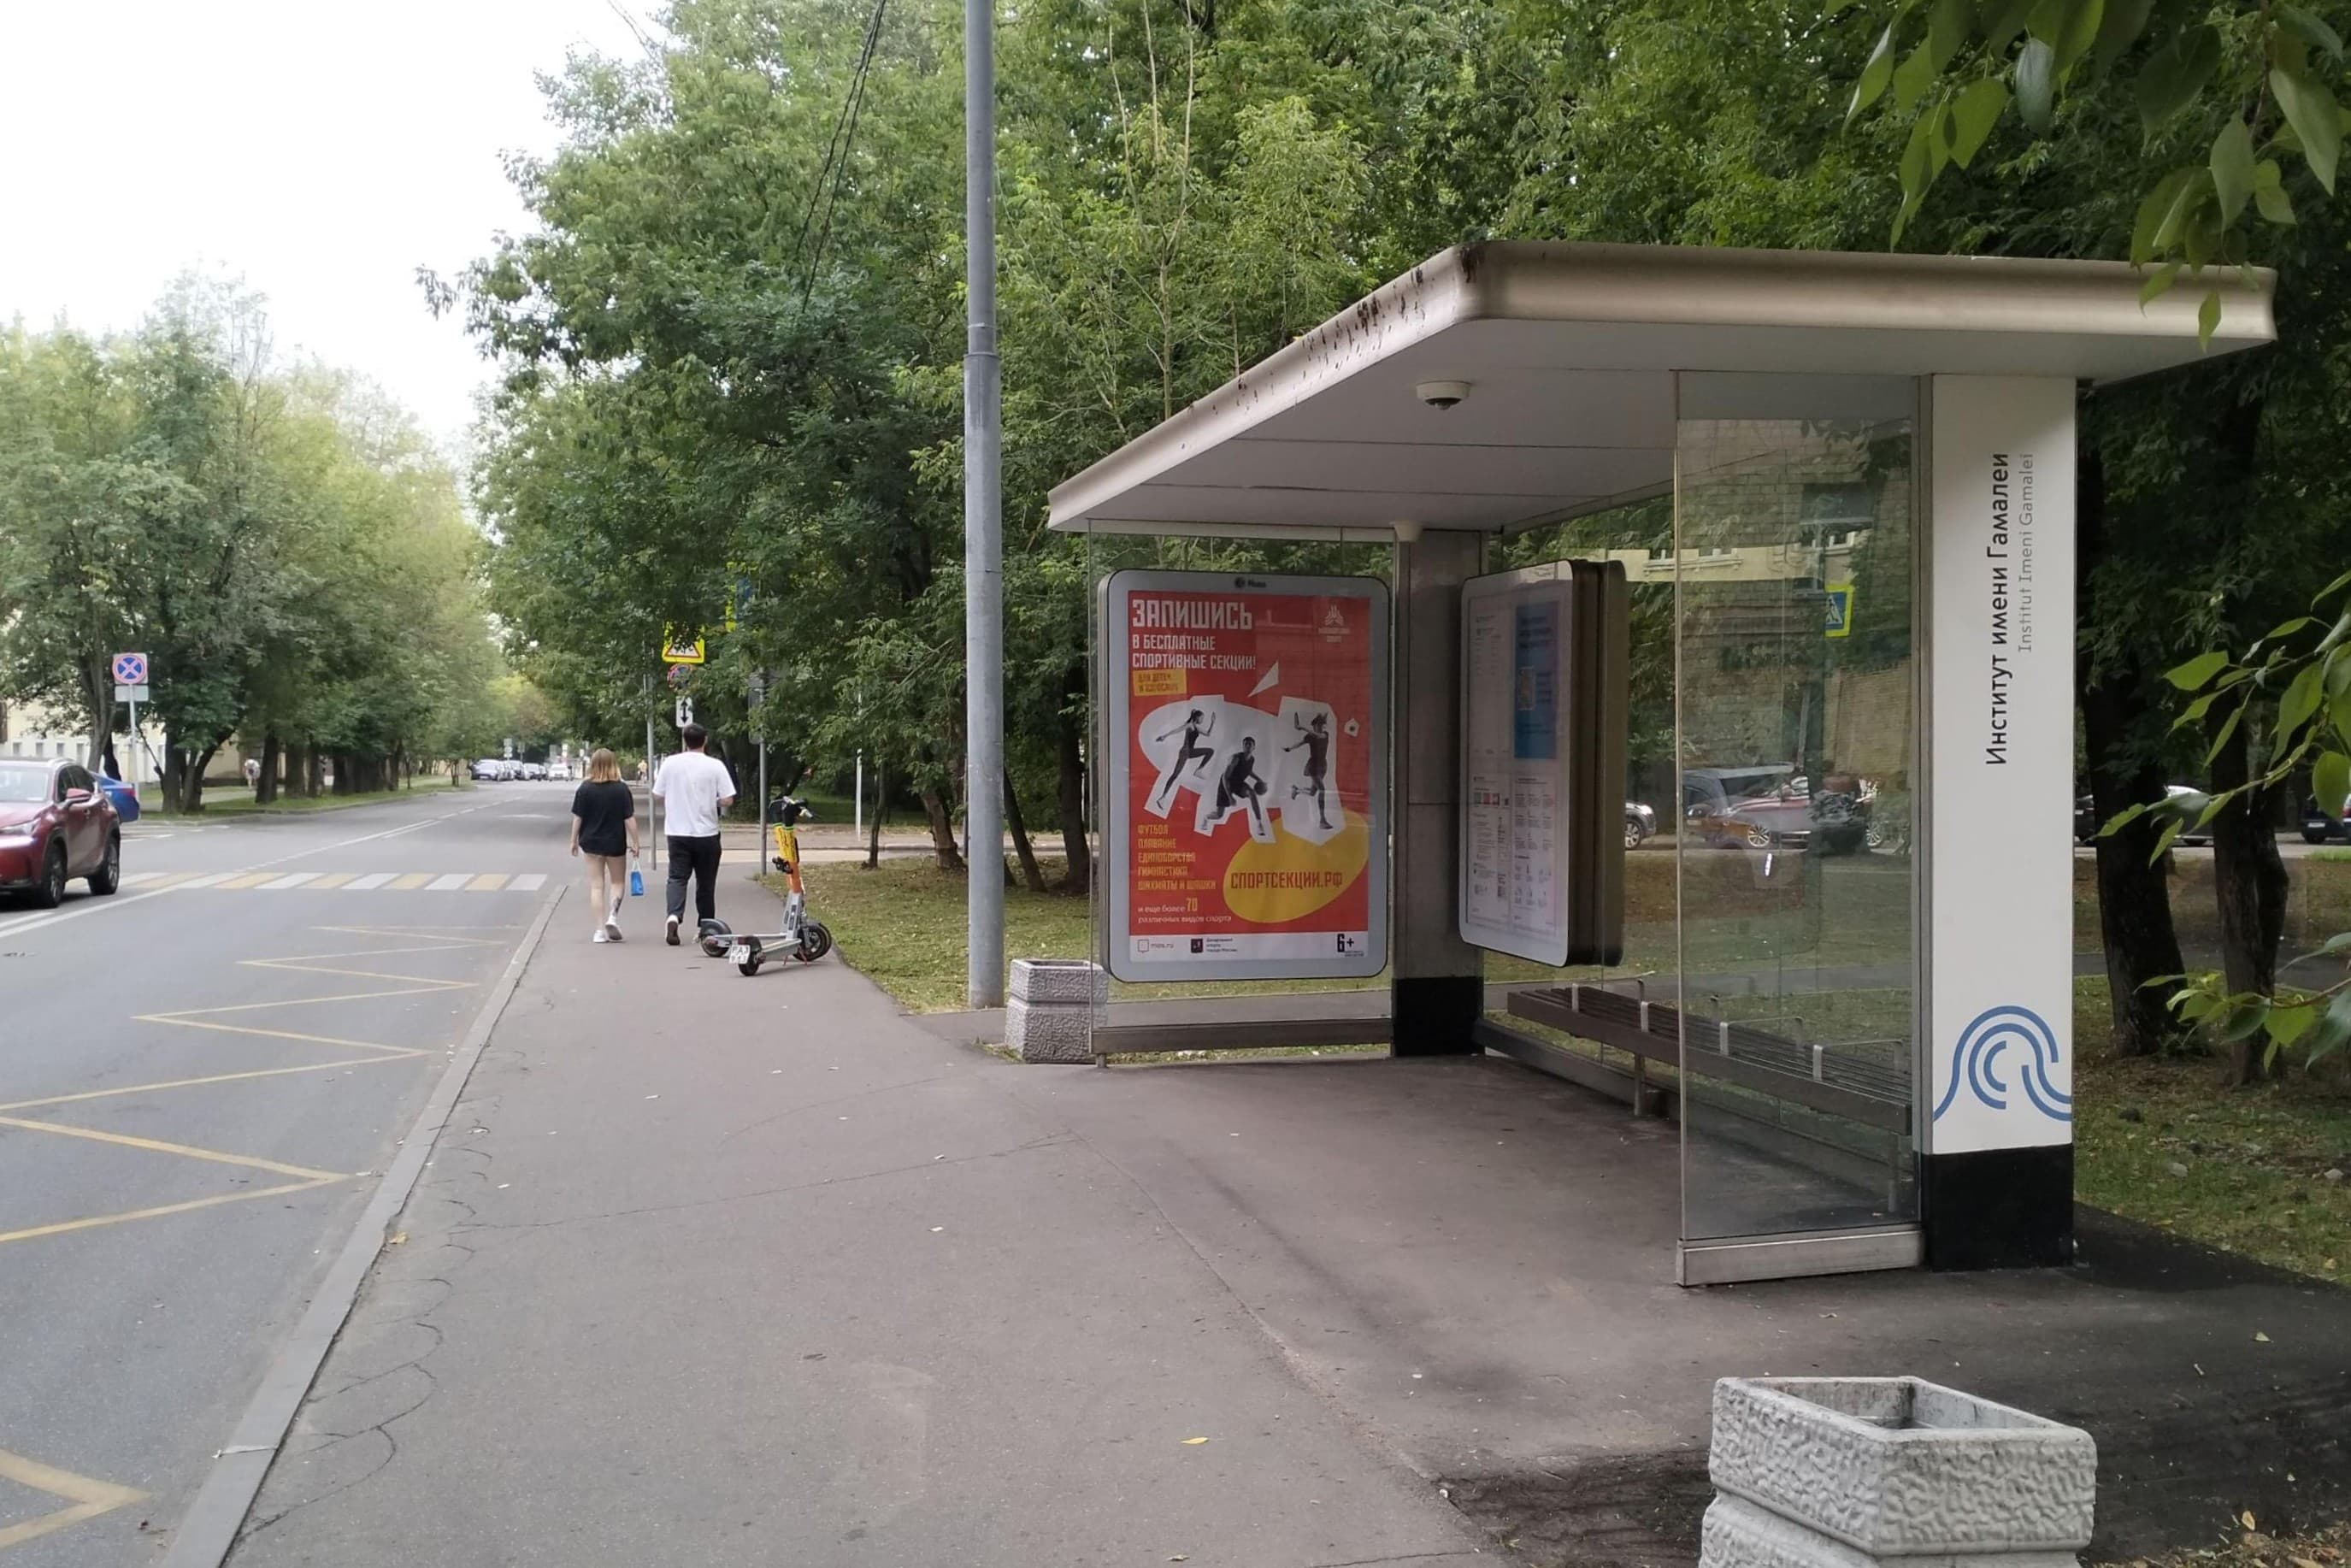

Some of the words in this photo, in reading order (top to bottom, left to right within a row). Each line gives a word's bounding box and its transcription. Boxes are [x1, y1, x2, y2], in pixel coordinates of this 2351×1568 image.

[2018, 453, 2033, 526] Gamalei
[1987, 453, 2008, 558] Гамалеи
[2018, 531, 2032, 582] Imeni
[1132, 598, 1252, 629] ЗАПИШИСЬ
[1991, 567, 2008, 645] имени
[2018, 587, 2032, 653] Institut
[1133, 634, 1140, 650] В
[1143, 634, 1216, 651] БЕСПЛАТНЫЕ
[1133, 652, 1207, 669] СПОРТИВНЫЕ
[1210, 654, 1256, 670] СЕКЦИИ!
[1985, 654, 2012, 765] Институт
[1137, 824, 1169, 835] ФУТБОЛ
[1138, 838, 1177, 849] ПЛАВАНИЕ
[1231, 870, 1342, 890] СПОРТСЕКЦИИ.РФ
[1186, 897, 1199, 911] 70
[1337, 933, 1354, 952] 6+
